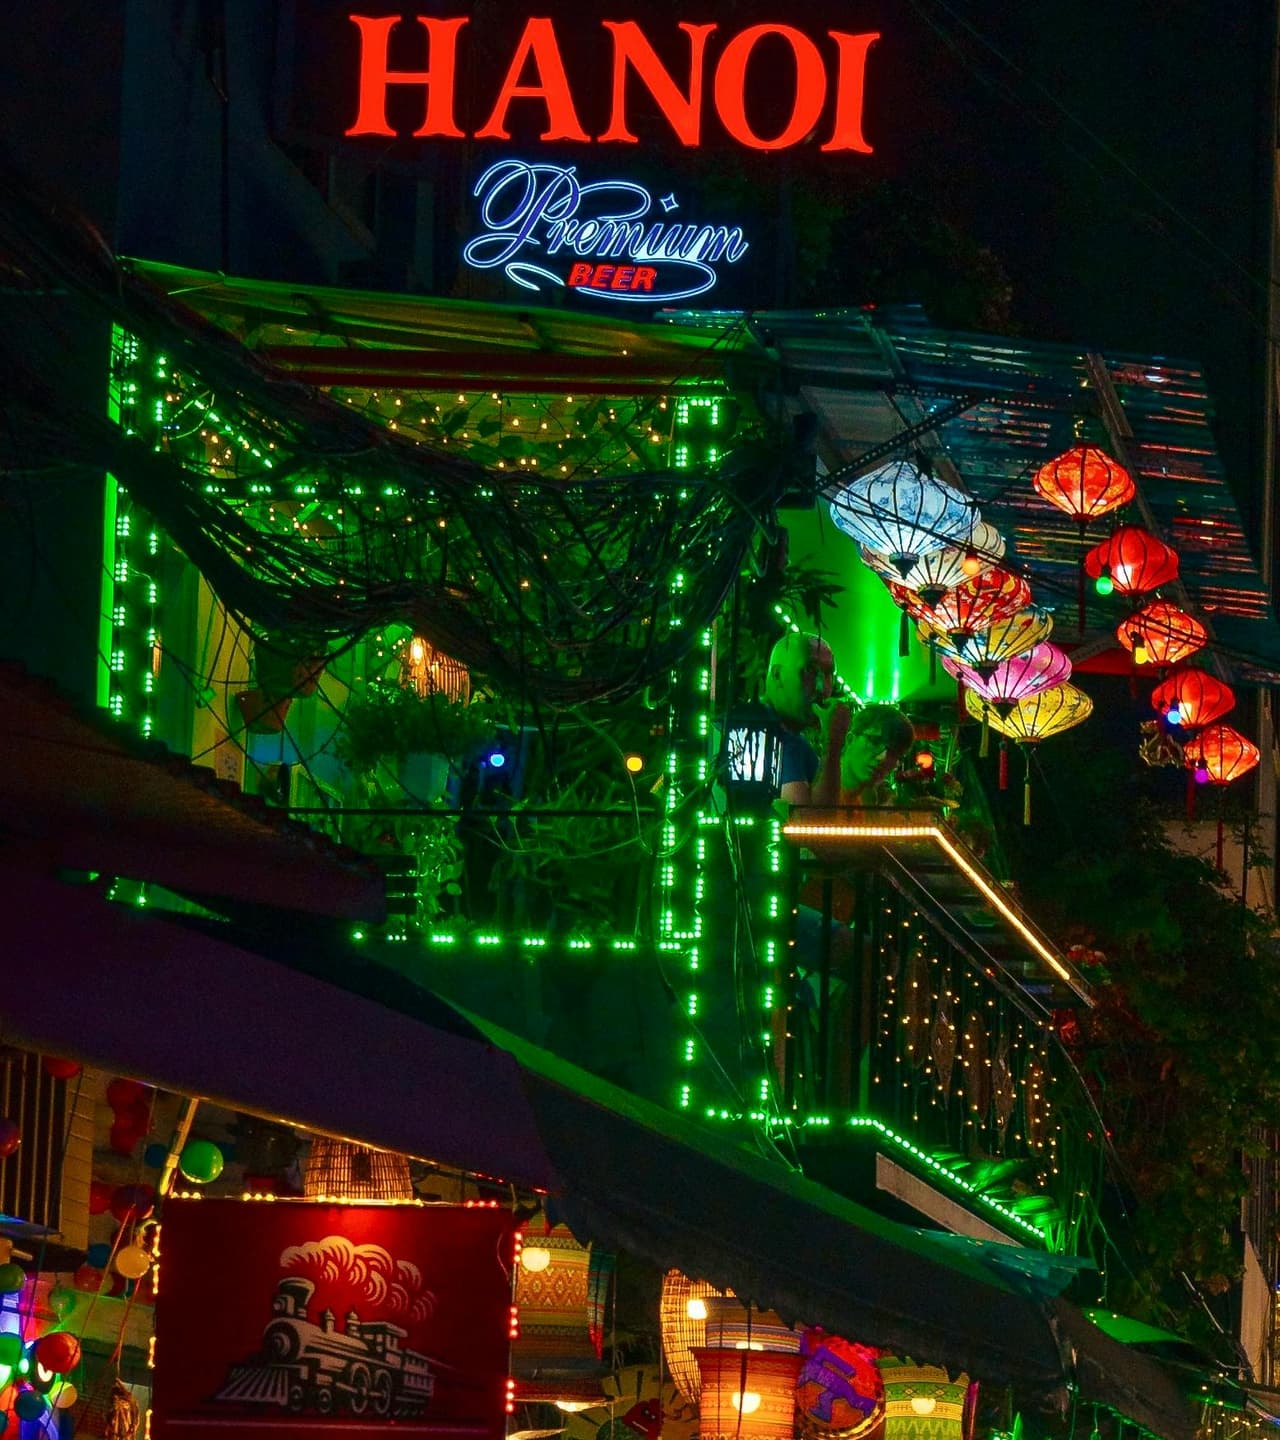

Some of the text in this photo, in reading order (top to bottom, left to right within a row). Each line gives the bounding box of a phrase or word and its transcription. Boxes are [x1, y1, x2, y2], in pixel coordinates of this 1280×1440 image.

[344, 13, 881, 154] HANOI
[463, 159, 749, 268] Premium
[567, 262, 656, 292] BEER
